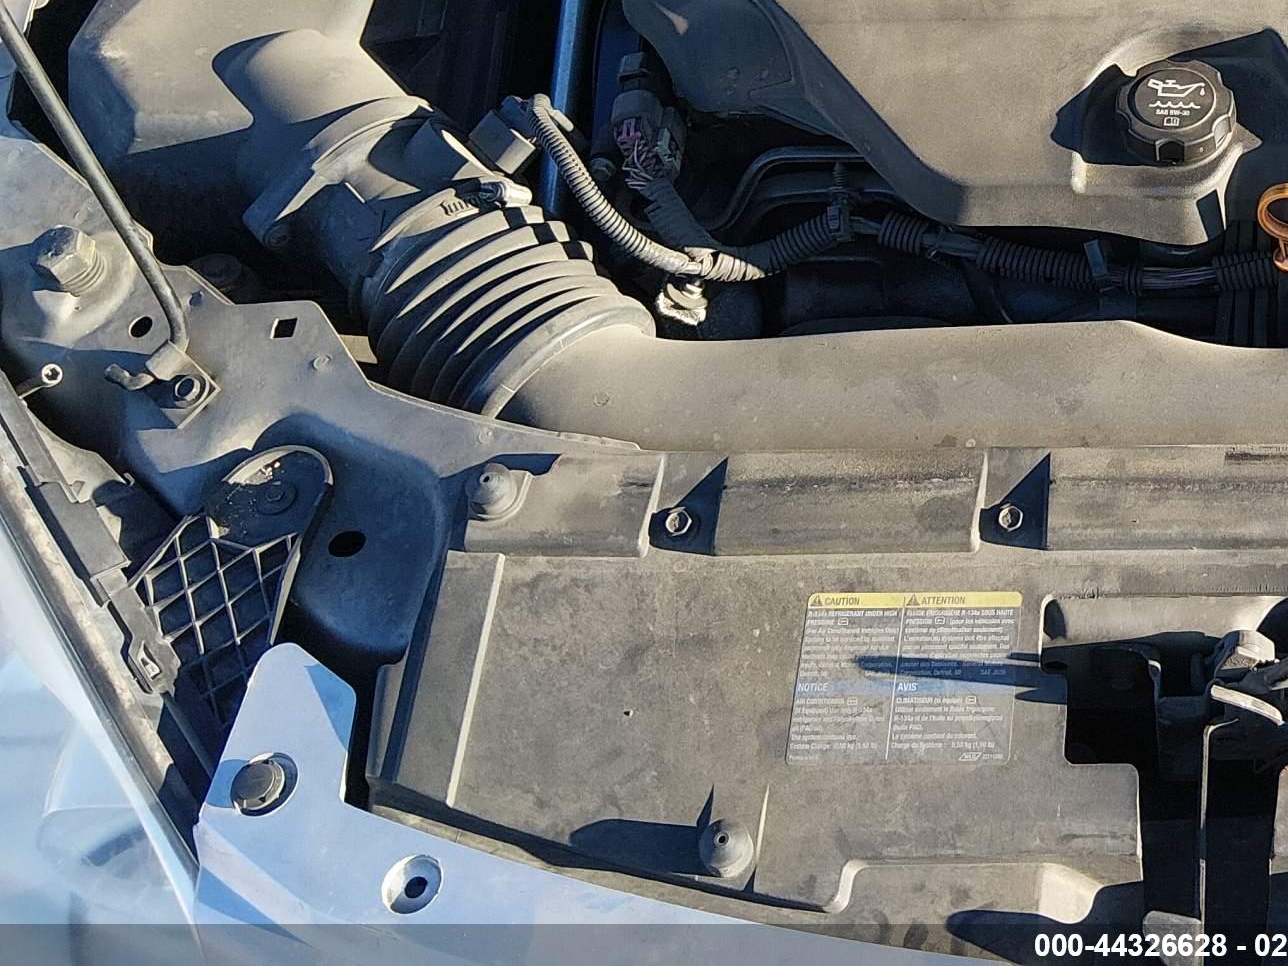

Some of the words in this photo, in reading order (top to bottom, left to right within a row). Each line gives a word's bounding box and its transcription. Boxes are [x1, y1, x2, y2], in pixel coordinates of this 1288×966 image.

[825, 597, 860, 606] CAUTION
[921, 596, 966, 605] ATTENTION
[797, 683, 829, 692] NOTICE
[897, 682, 918, 691] AVIS
